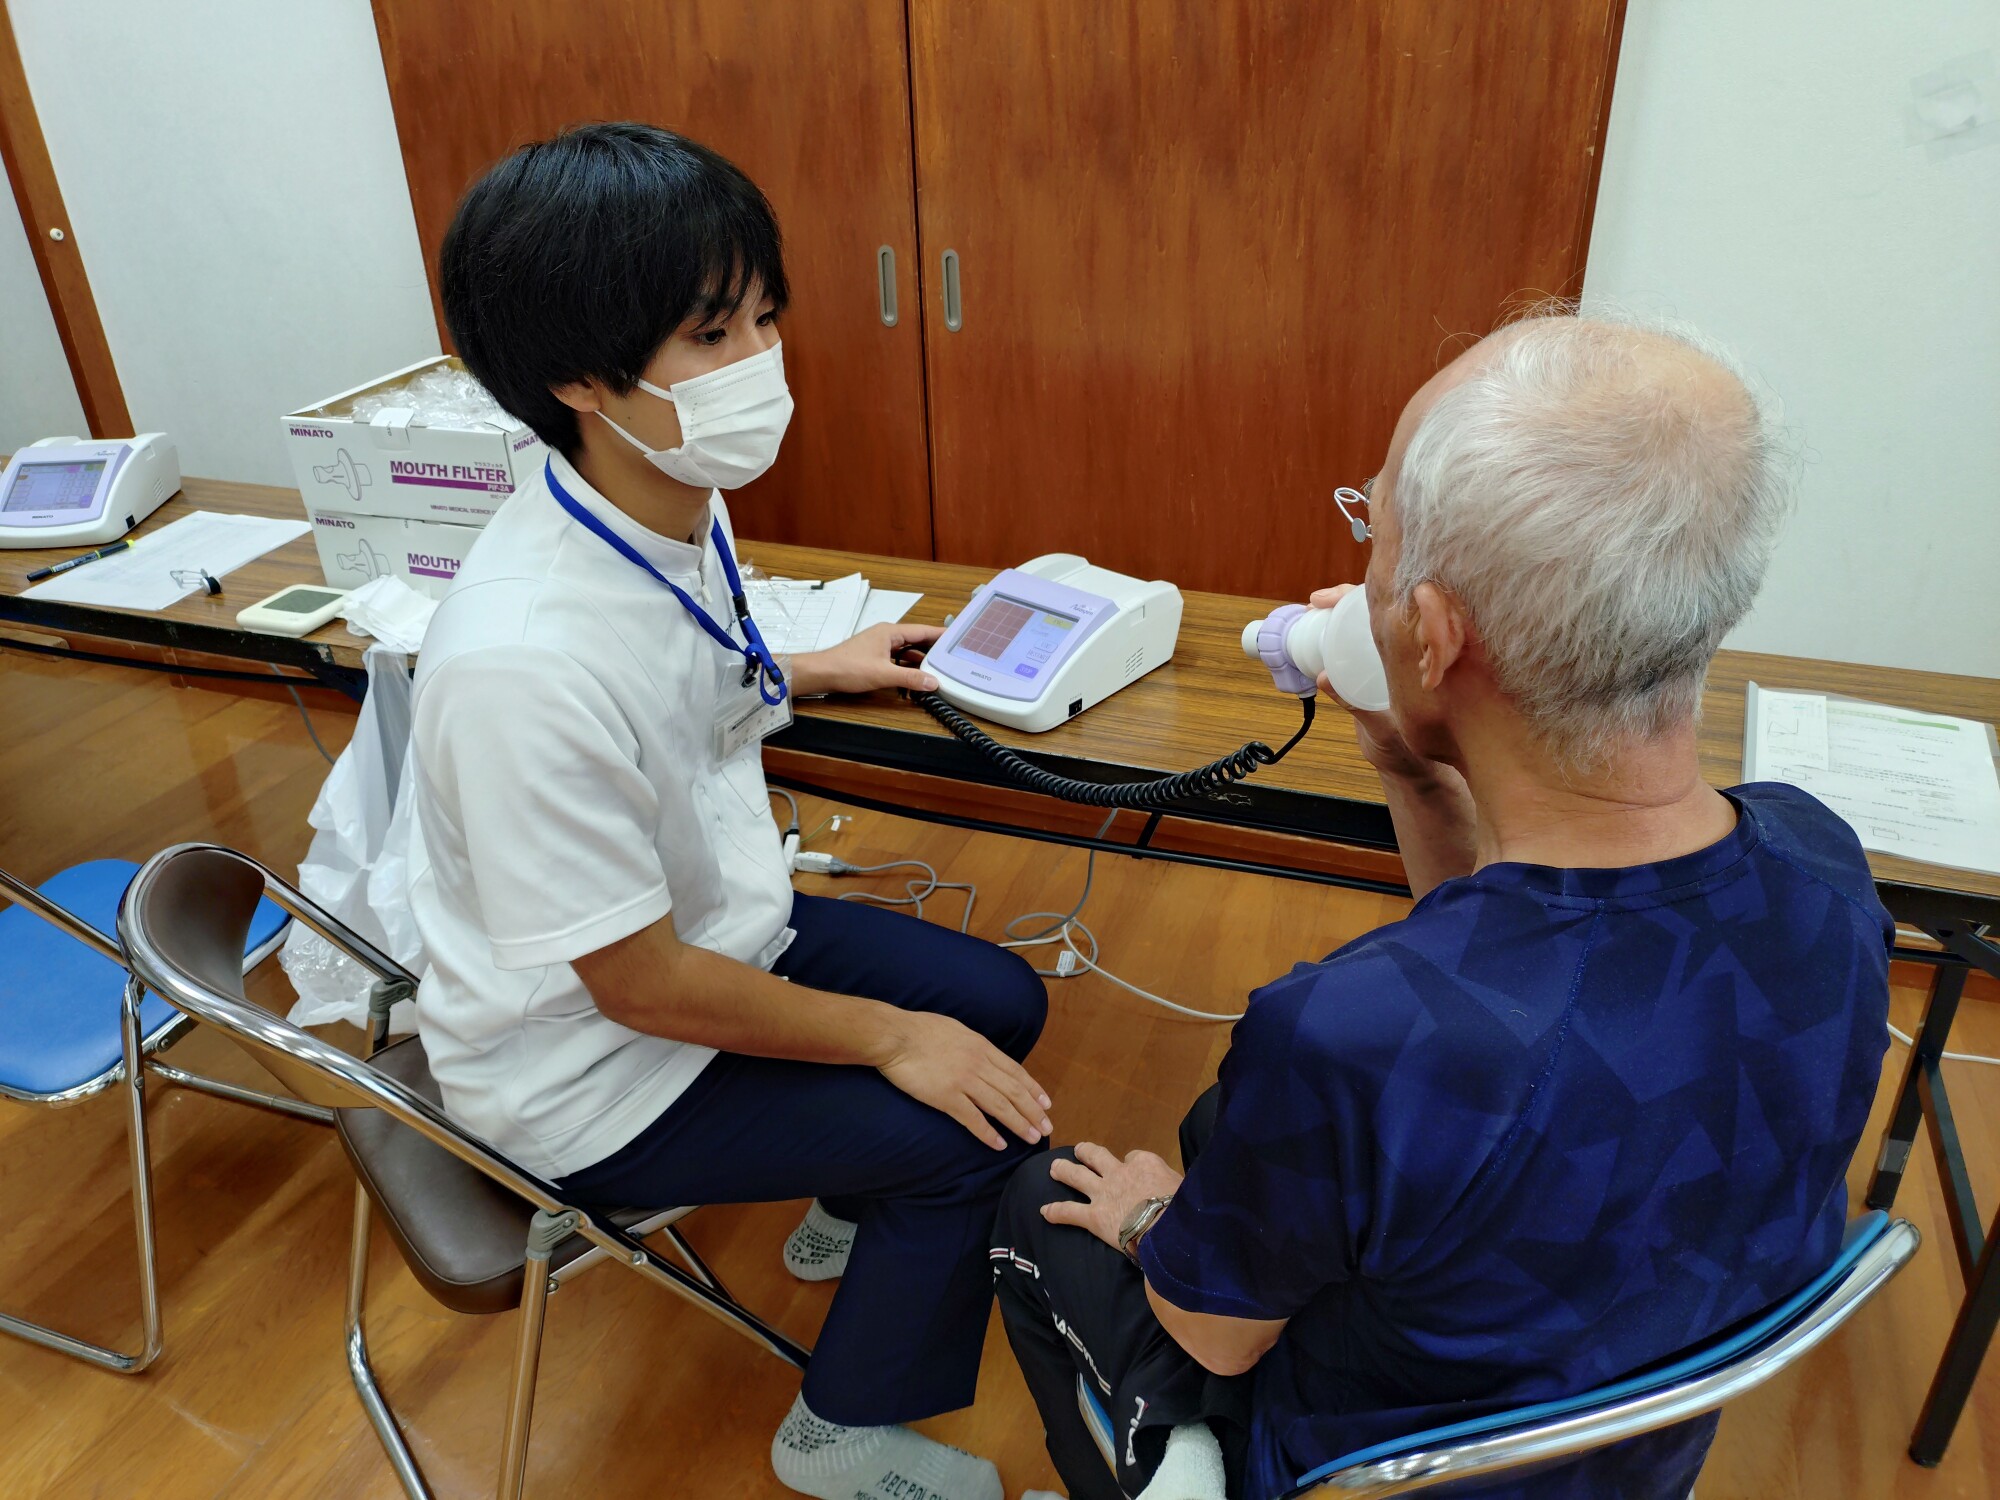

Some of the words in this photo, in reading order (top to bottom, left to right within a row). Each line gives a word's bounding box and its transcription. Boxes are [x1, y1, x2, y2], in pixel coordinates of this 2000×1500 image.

[290, 427, 334, 438] MINATO
[513, 434, 540, 452] MINAT
[390, 460, 448, 477] MOUTH
[452, 465, 507, 482] FILTER
[315, 517, 355, 529] MINATO
[407, 552, 461, 570] MOUTH
[970, 670, 992, 682] MINATO
